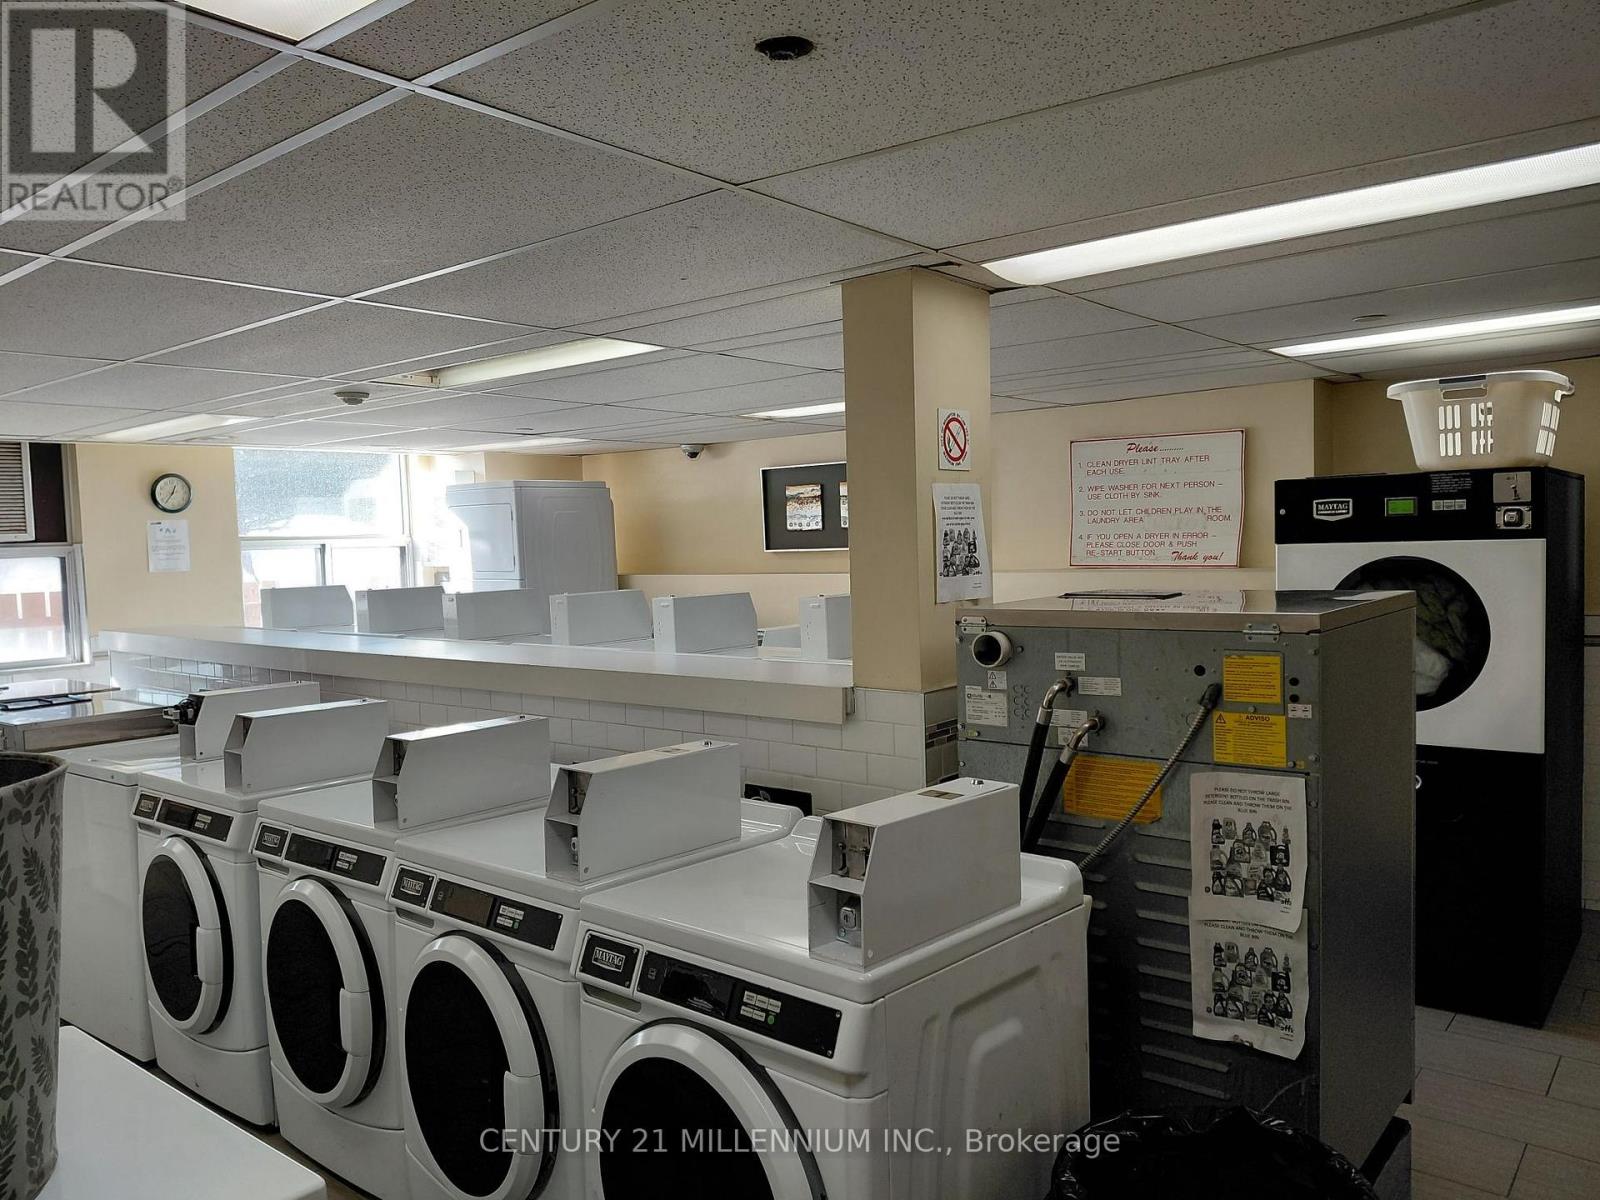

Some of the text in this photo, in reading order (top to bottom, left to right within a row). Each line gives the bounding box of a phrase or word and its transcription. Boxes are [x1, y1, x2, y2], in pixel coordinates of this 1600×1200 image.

[1086, 460, 1112, 468] CLEAN
[1114, 459, 1139, 467] DRYER
[1161, 456, 1180, 464] TRAY
[1184, 455, 1210, 463] AFTER
[1086, 468, 1107, 476] EACH
[1184, 480, 1215, 488] PERSON
[1104, 492, 1129, 500] CLOTH
[1136, 507, 1172, 515] CHILDREN
[1123, 516, 1144, 524] AREA
[1172, 551, 1224, 563] Thank you!
[595, 949, 623, 966] MAYTAG
